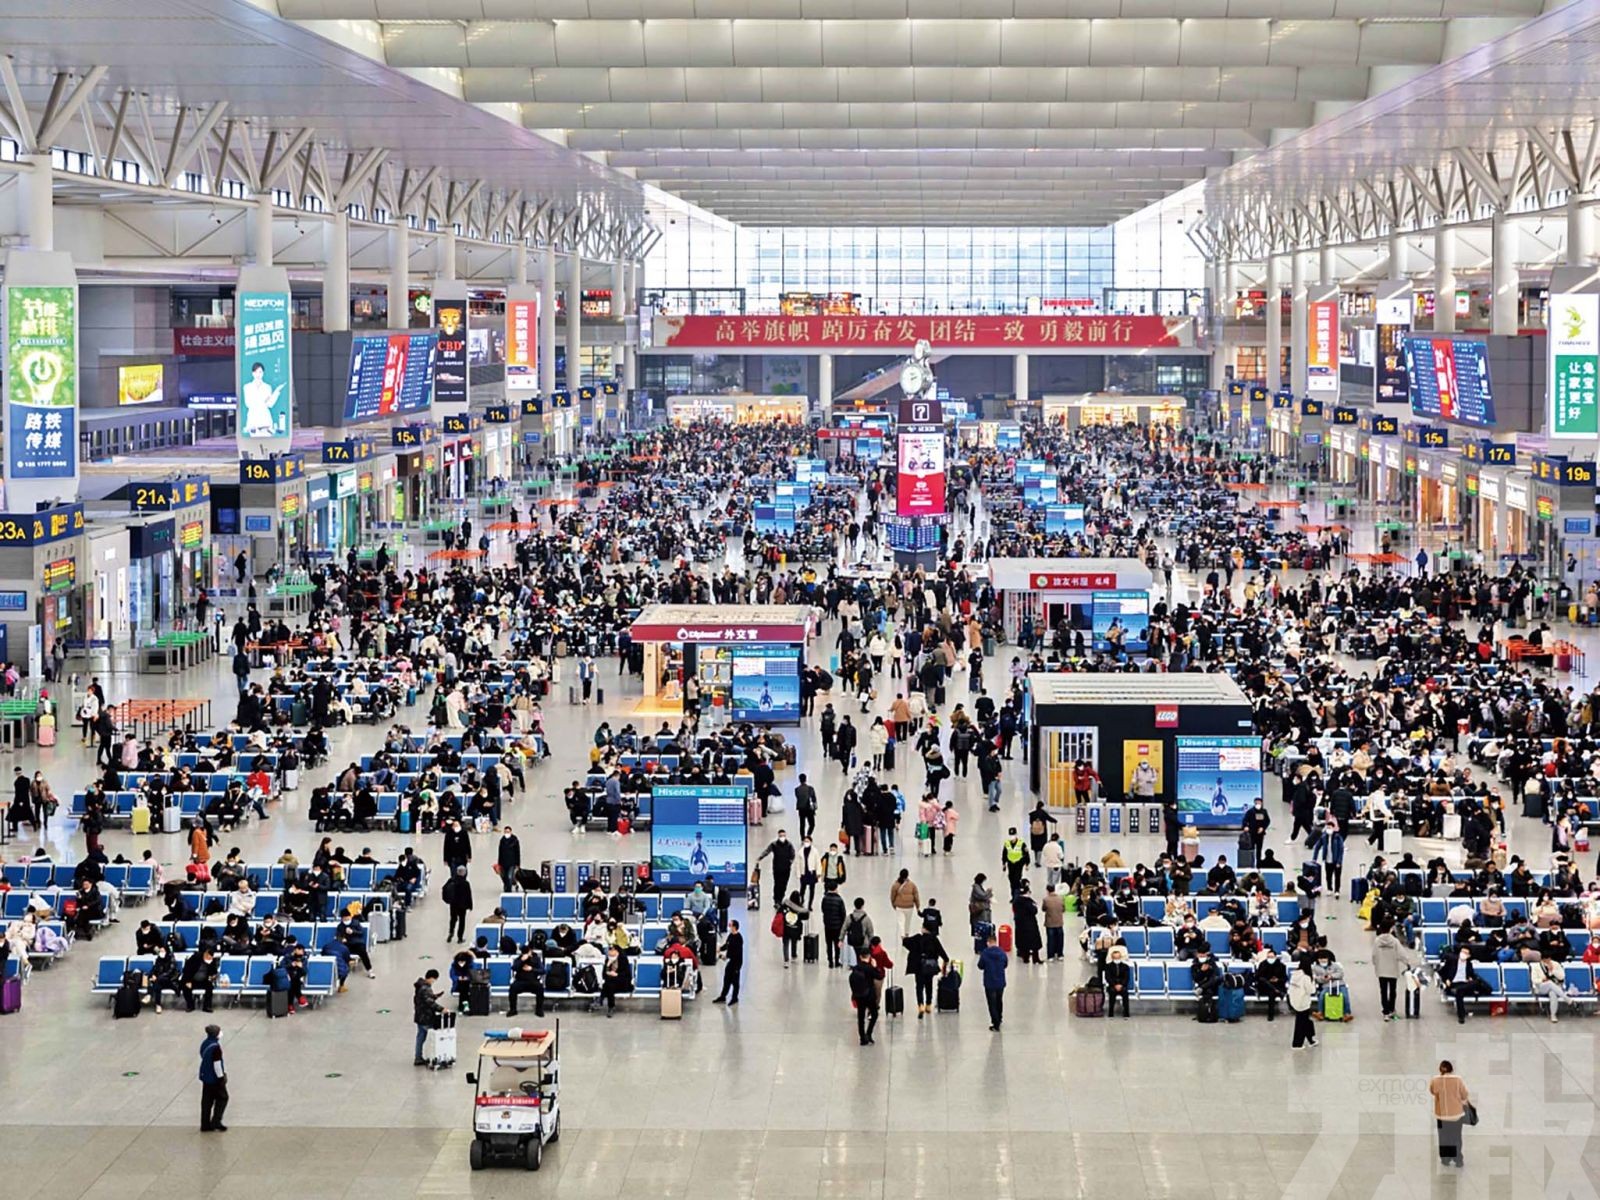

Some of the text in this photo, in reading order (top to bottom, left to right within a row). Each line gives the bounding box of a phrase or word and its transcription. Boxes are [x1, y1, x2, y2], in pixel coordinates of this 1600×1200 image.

[716, 319, 1134, 342] 高举旗帜 踔厉奋发 团结一致 勇毅前行
[437, 341, 462, 351] CBD
[1568, 362, 1581, 420] 让家更好
[448, 420, 465, 430] 13A
[396, 431, 416, 443] 15A
[327, 447, 349, 459] 17A
[1488, 448, 1511, 461] 17B
[245, 464, 270, 479] 19A
[1566, 467, 1591, 481] 19B
[136, 488, 166, 505] 21A
[724, 628, 758, 640] 外交官
[1156, 711, 1178, 721] LEGO
[657, 787, 696, 796] Hisense
